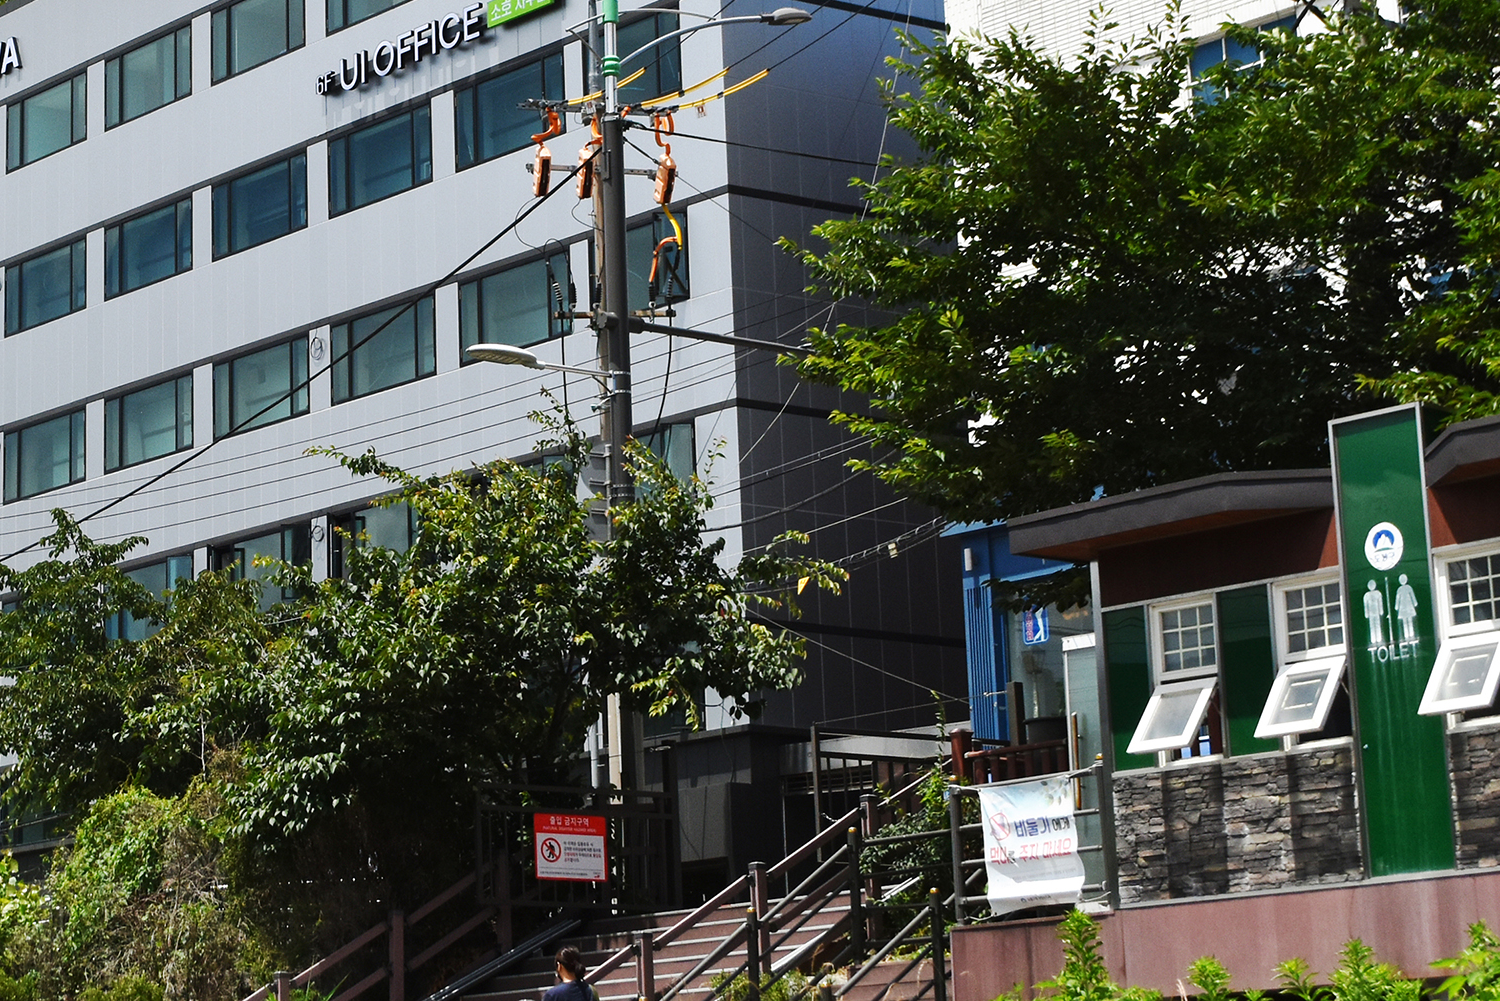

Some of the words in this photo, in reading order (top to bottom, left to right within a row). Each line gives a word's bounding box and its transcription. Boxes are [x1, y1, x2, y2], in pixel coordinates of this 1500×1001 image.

[491, 0, 512, 21] 소호
[315, 70, 334, 95] 6F
[372, 1, 483, 77] OFFICE
[1367, 639, 1419, 663] TOILET
[1019, 843, 1039, 862] 주지
